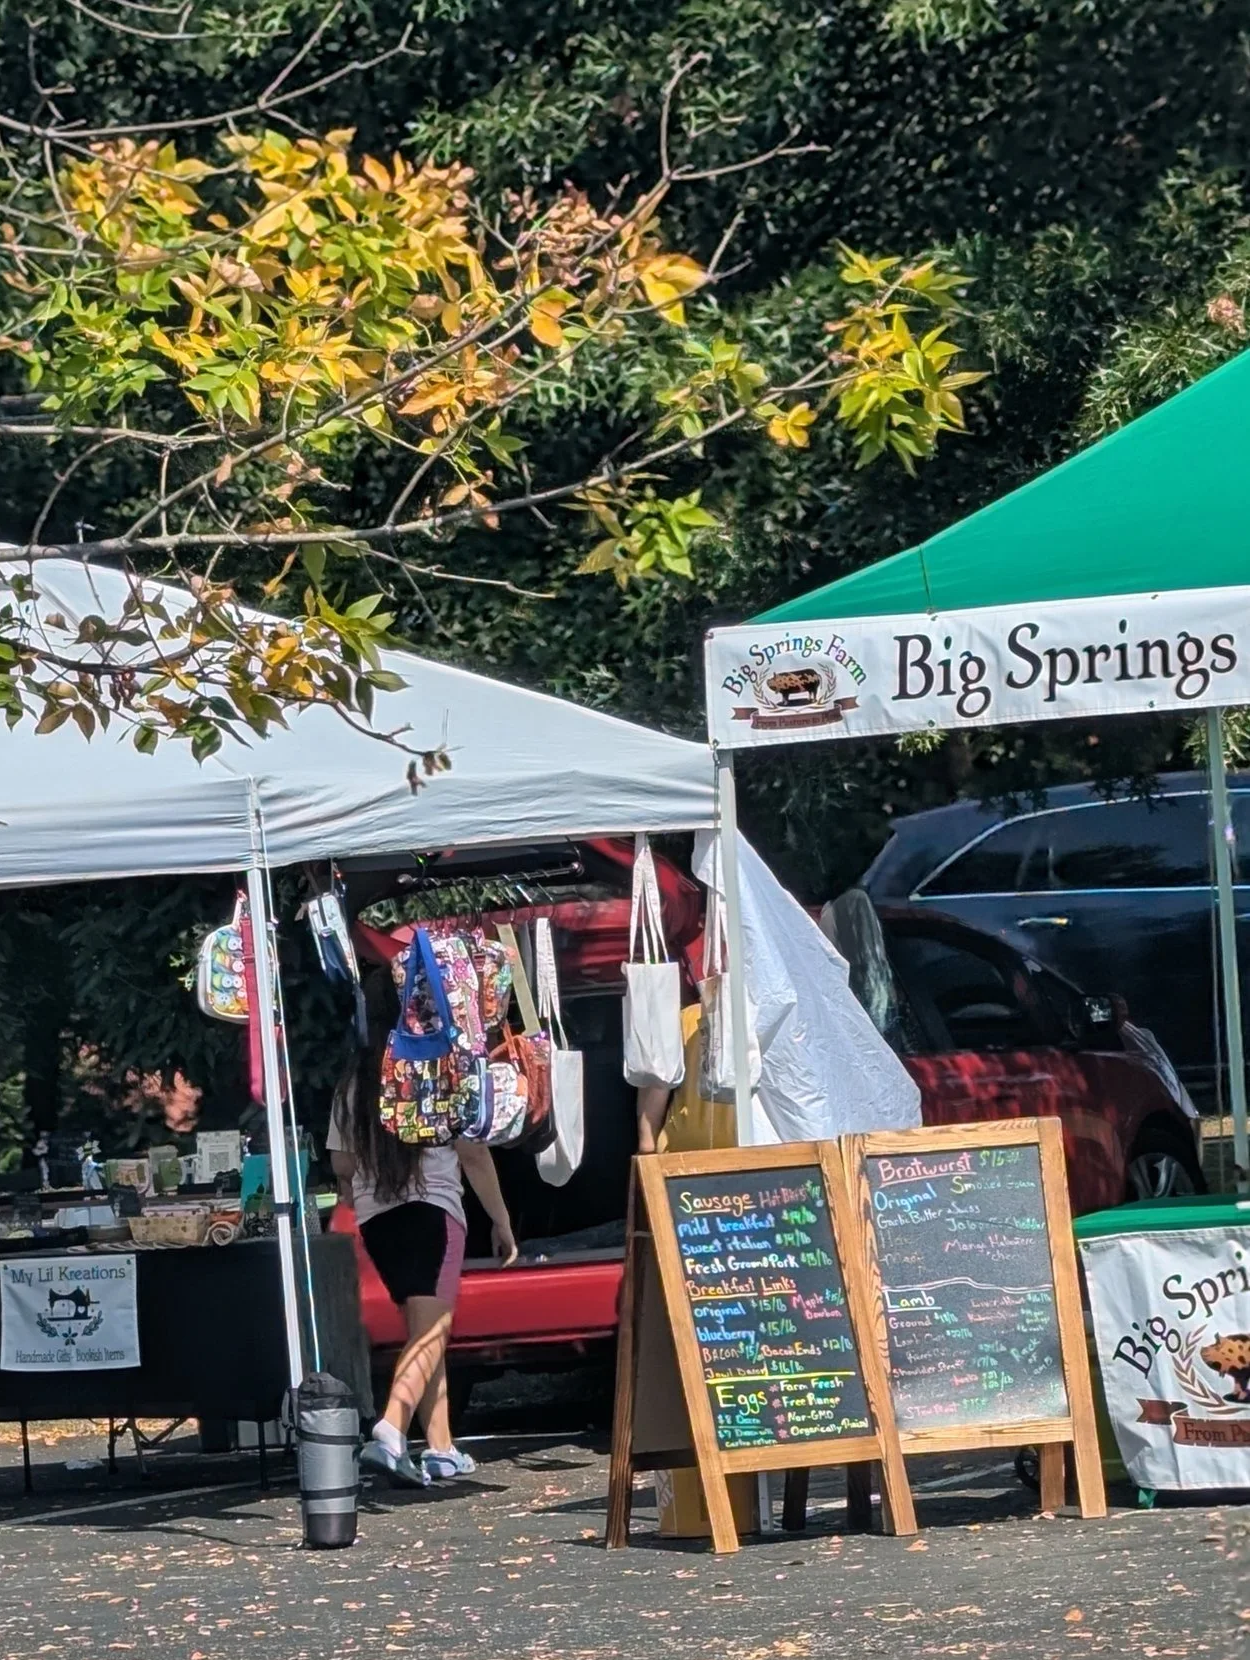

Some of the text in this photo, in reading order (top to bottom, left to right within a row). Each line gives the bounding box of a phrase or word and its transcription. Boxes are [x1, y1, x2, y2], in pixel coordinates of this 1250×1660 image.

[721, 632, 867, 697] Big Springs Farm
[892, 618, 1237, 718] Big Springs
[878, 1152, 972, 1182] Bratwurst
[680, 1192, 753, 1217] Sausage
[874, 1183, 938, 1213] Original
[716, 1213, 775, 1233] breakfast
[910, 1208, 943, 1225] Butter
[726, 1236, 771, 1252] italian
[685, 1257, 726, 1275] Fresh
[728, 1255, 768, 1271] Ground
[768, 1253, 799, 1268] Pork
[11, 1265, 126, 1287] My Lil Kreations
[686, 1276, 796, 1297] Breakfast Links
[792, 1293, 824, 1309] Maple
[885, 1290, 936, 1309] Lamb
[694, 1297, 788, 1325] original $15/lb
[696, 1318, 797, 1346] blueberry $15/lb
[889, 1316, 933, 1330] Ground
[15, 1349, 55, 1363] Handmade
[76, 1348, 103, 1361] Bookish
[103, 1347, 126, 1361] Items
[795, 1341, 822, 1356] Ends
[1113, 1316, 1181, 1379] Big
[780, 1376, 844, 1391] Farm Fresh
[716, 1385, 768, 1416] Eggs
[781, 1393, 841, 1408] Free Range
[790, 1421, 843, 1436] Organically
[1183, 1422, 1226, 1441] From
